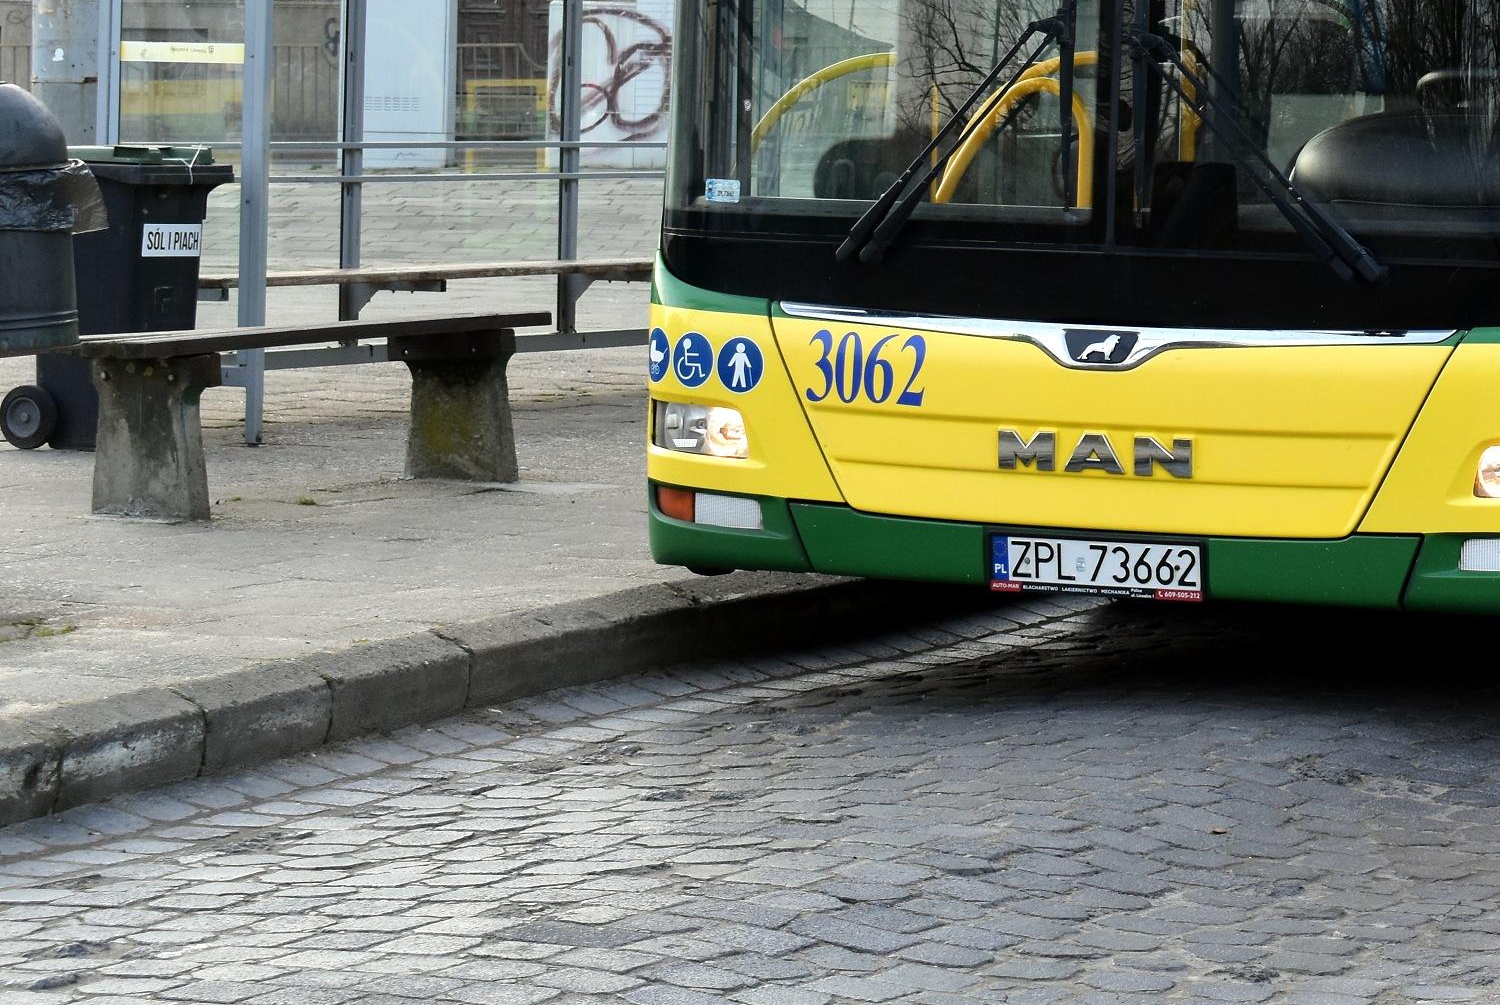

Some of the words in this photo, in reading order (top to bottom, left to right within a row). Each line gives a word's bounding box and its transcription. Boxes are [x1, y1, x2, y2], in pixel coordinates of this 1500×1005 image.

[147, 227, 165, 250] SÓL
[168, 231, 172, 250] I
[173, 231, 200, 250] PIACH
[806, 329, 926, 407] 3062
[998, 429, 1193, 478] MAN
[994, 562, 1007, 574] PL
[1011, 540, 1076, 581] ZPL
[1089, 544, 1197, 587] 73662
[992, 582, 1020, 590] AUTO-MAR
[1164, 591, 1200, 599] 609-505-212
